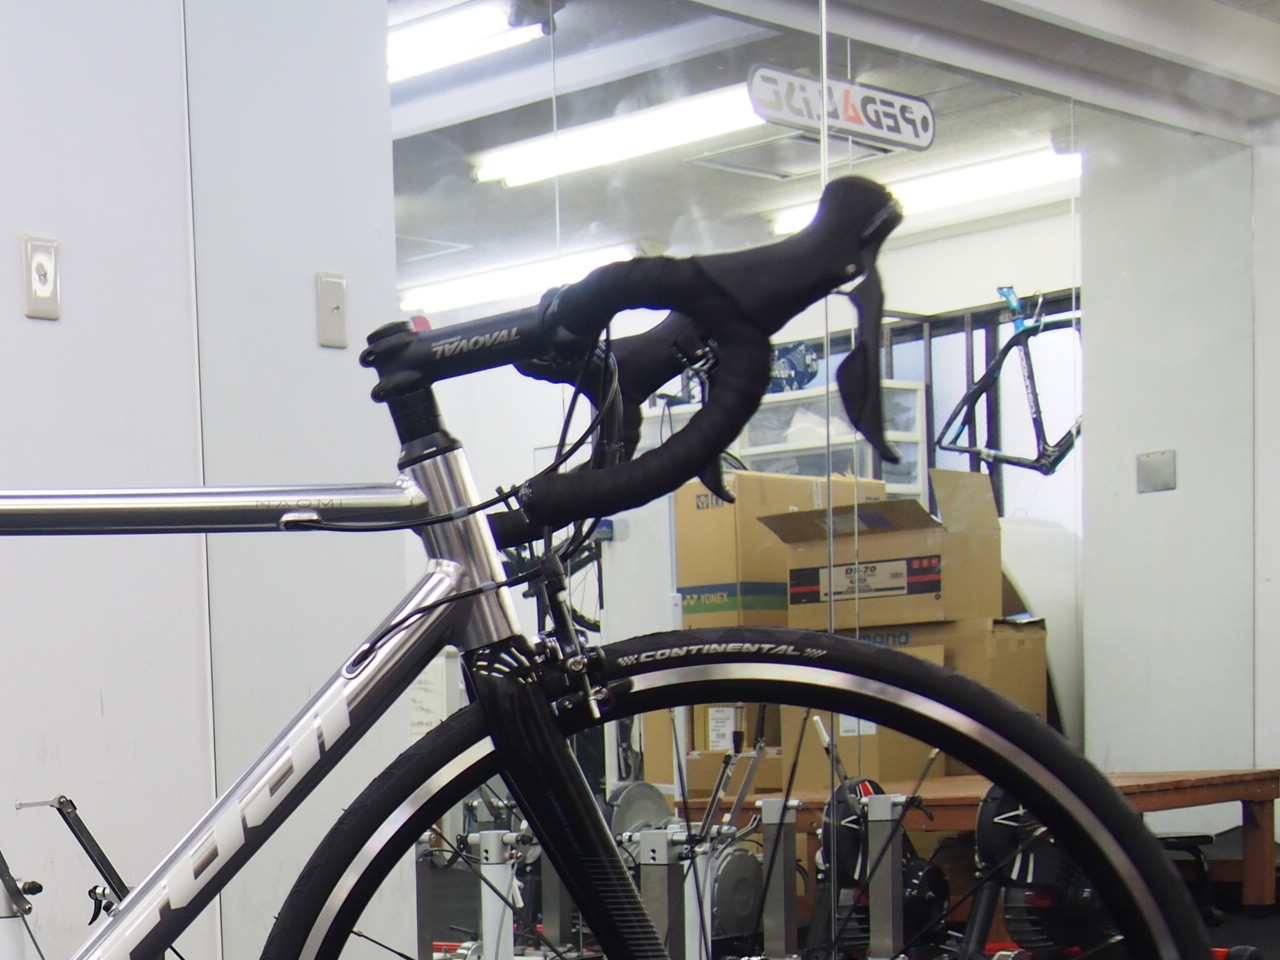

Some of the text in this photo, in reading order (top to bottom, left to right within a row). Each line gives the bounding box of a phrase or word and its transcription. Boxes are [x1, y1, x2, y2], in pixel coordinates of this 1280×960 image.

[255, 498, 343, 510] NAOMI
[702, 592, 728, 603] YONEX
[639, 642, 801, 663] CONTINENTAL
